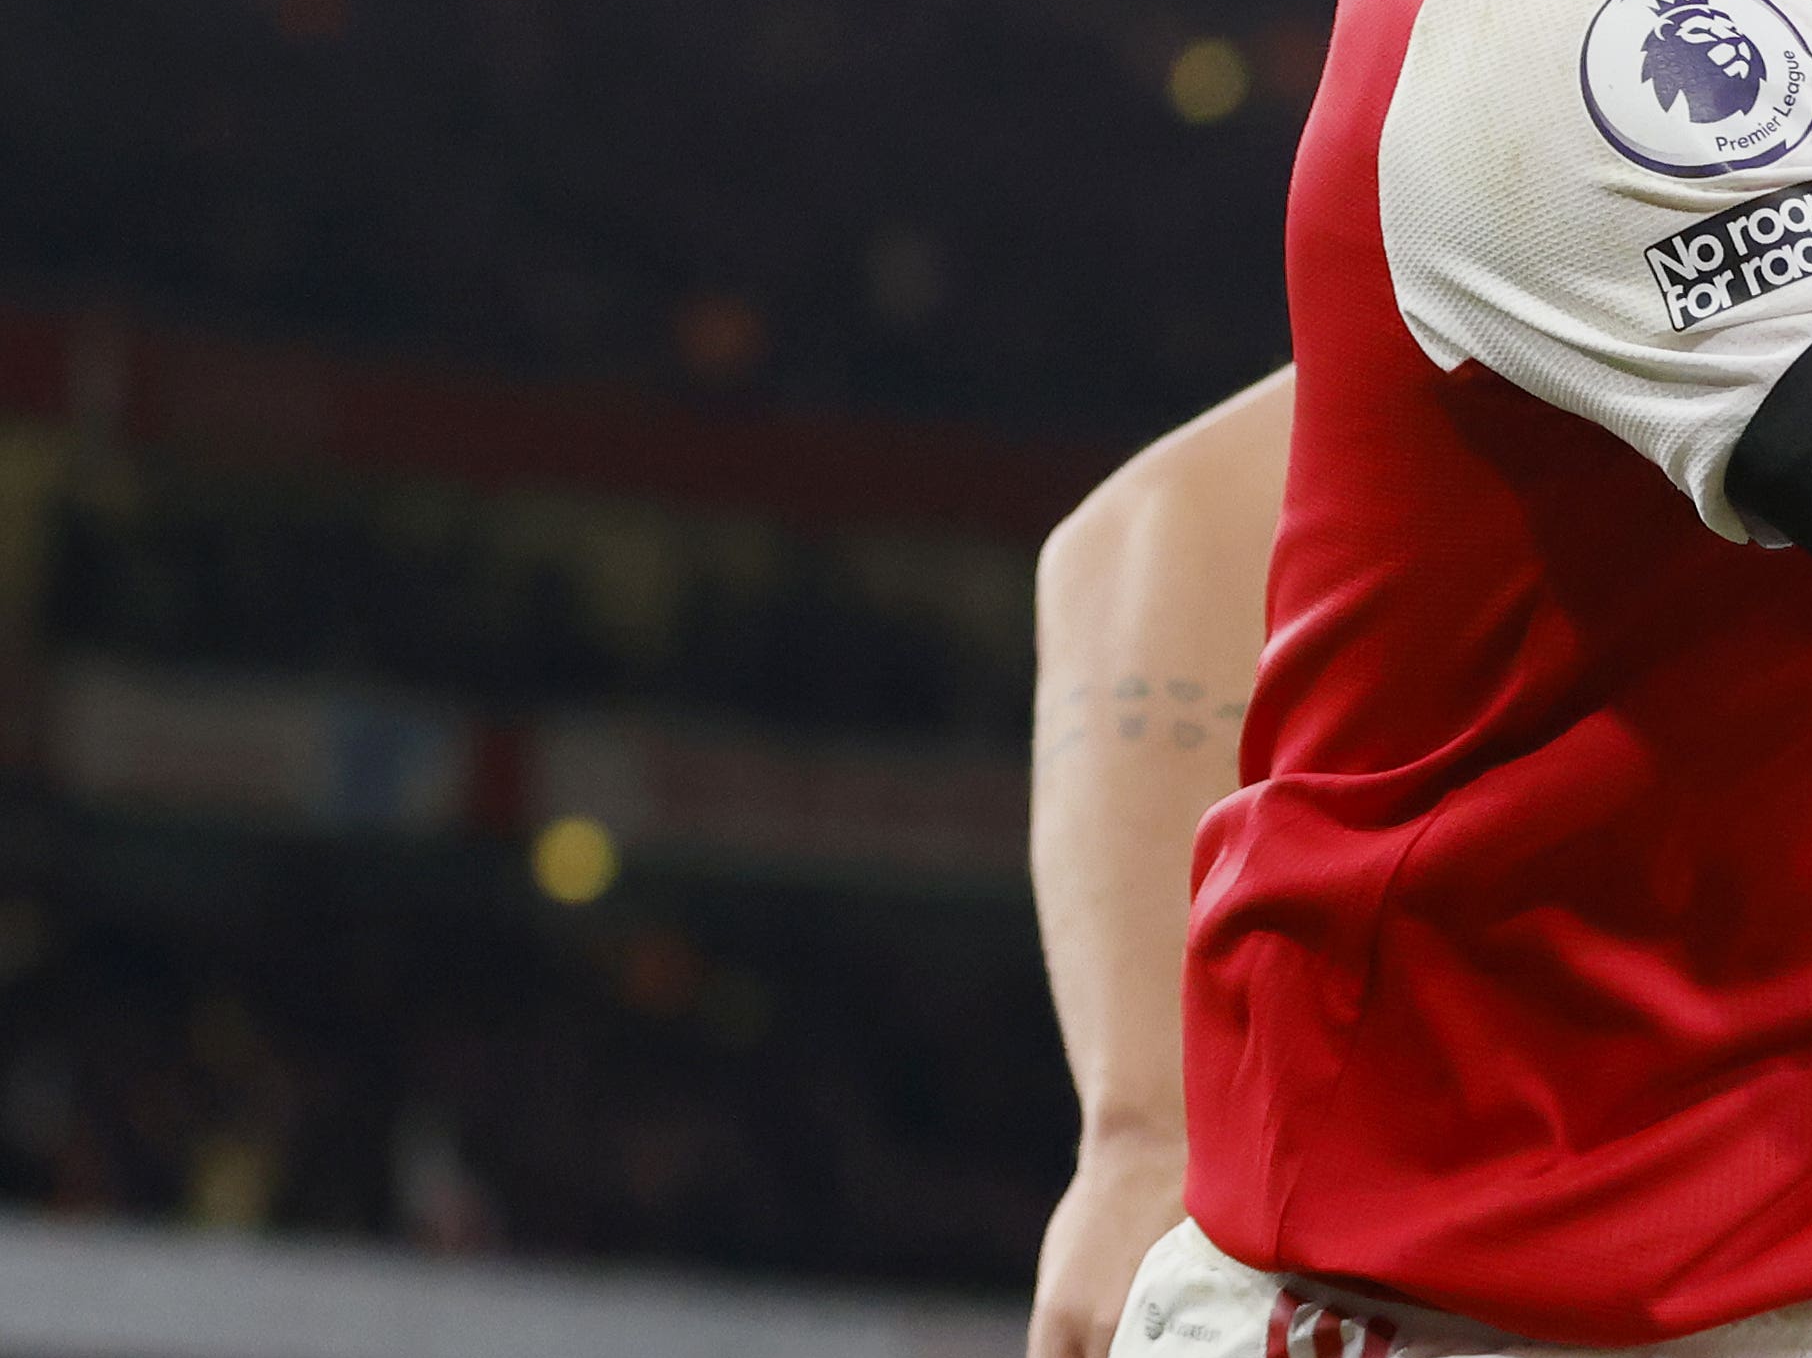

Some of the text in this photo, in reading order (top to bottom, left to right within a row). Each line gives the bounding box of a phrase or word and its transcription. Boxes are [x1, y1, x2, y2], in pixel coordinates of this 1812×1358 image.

[1715, 50, 1806, 152] Premier League
[1646, 235, 1724, 292] No
[1666, 269, 1734, 330] for
